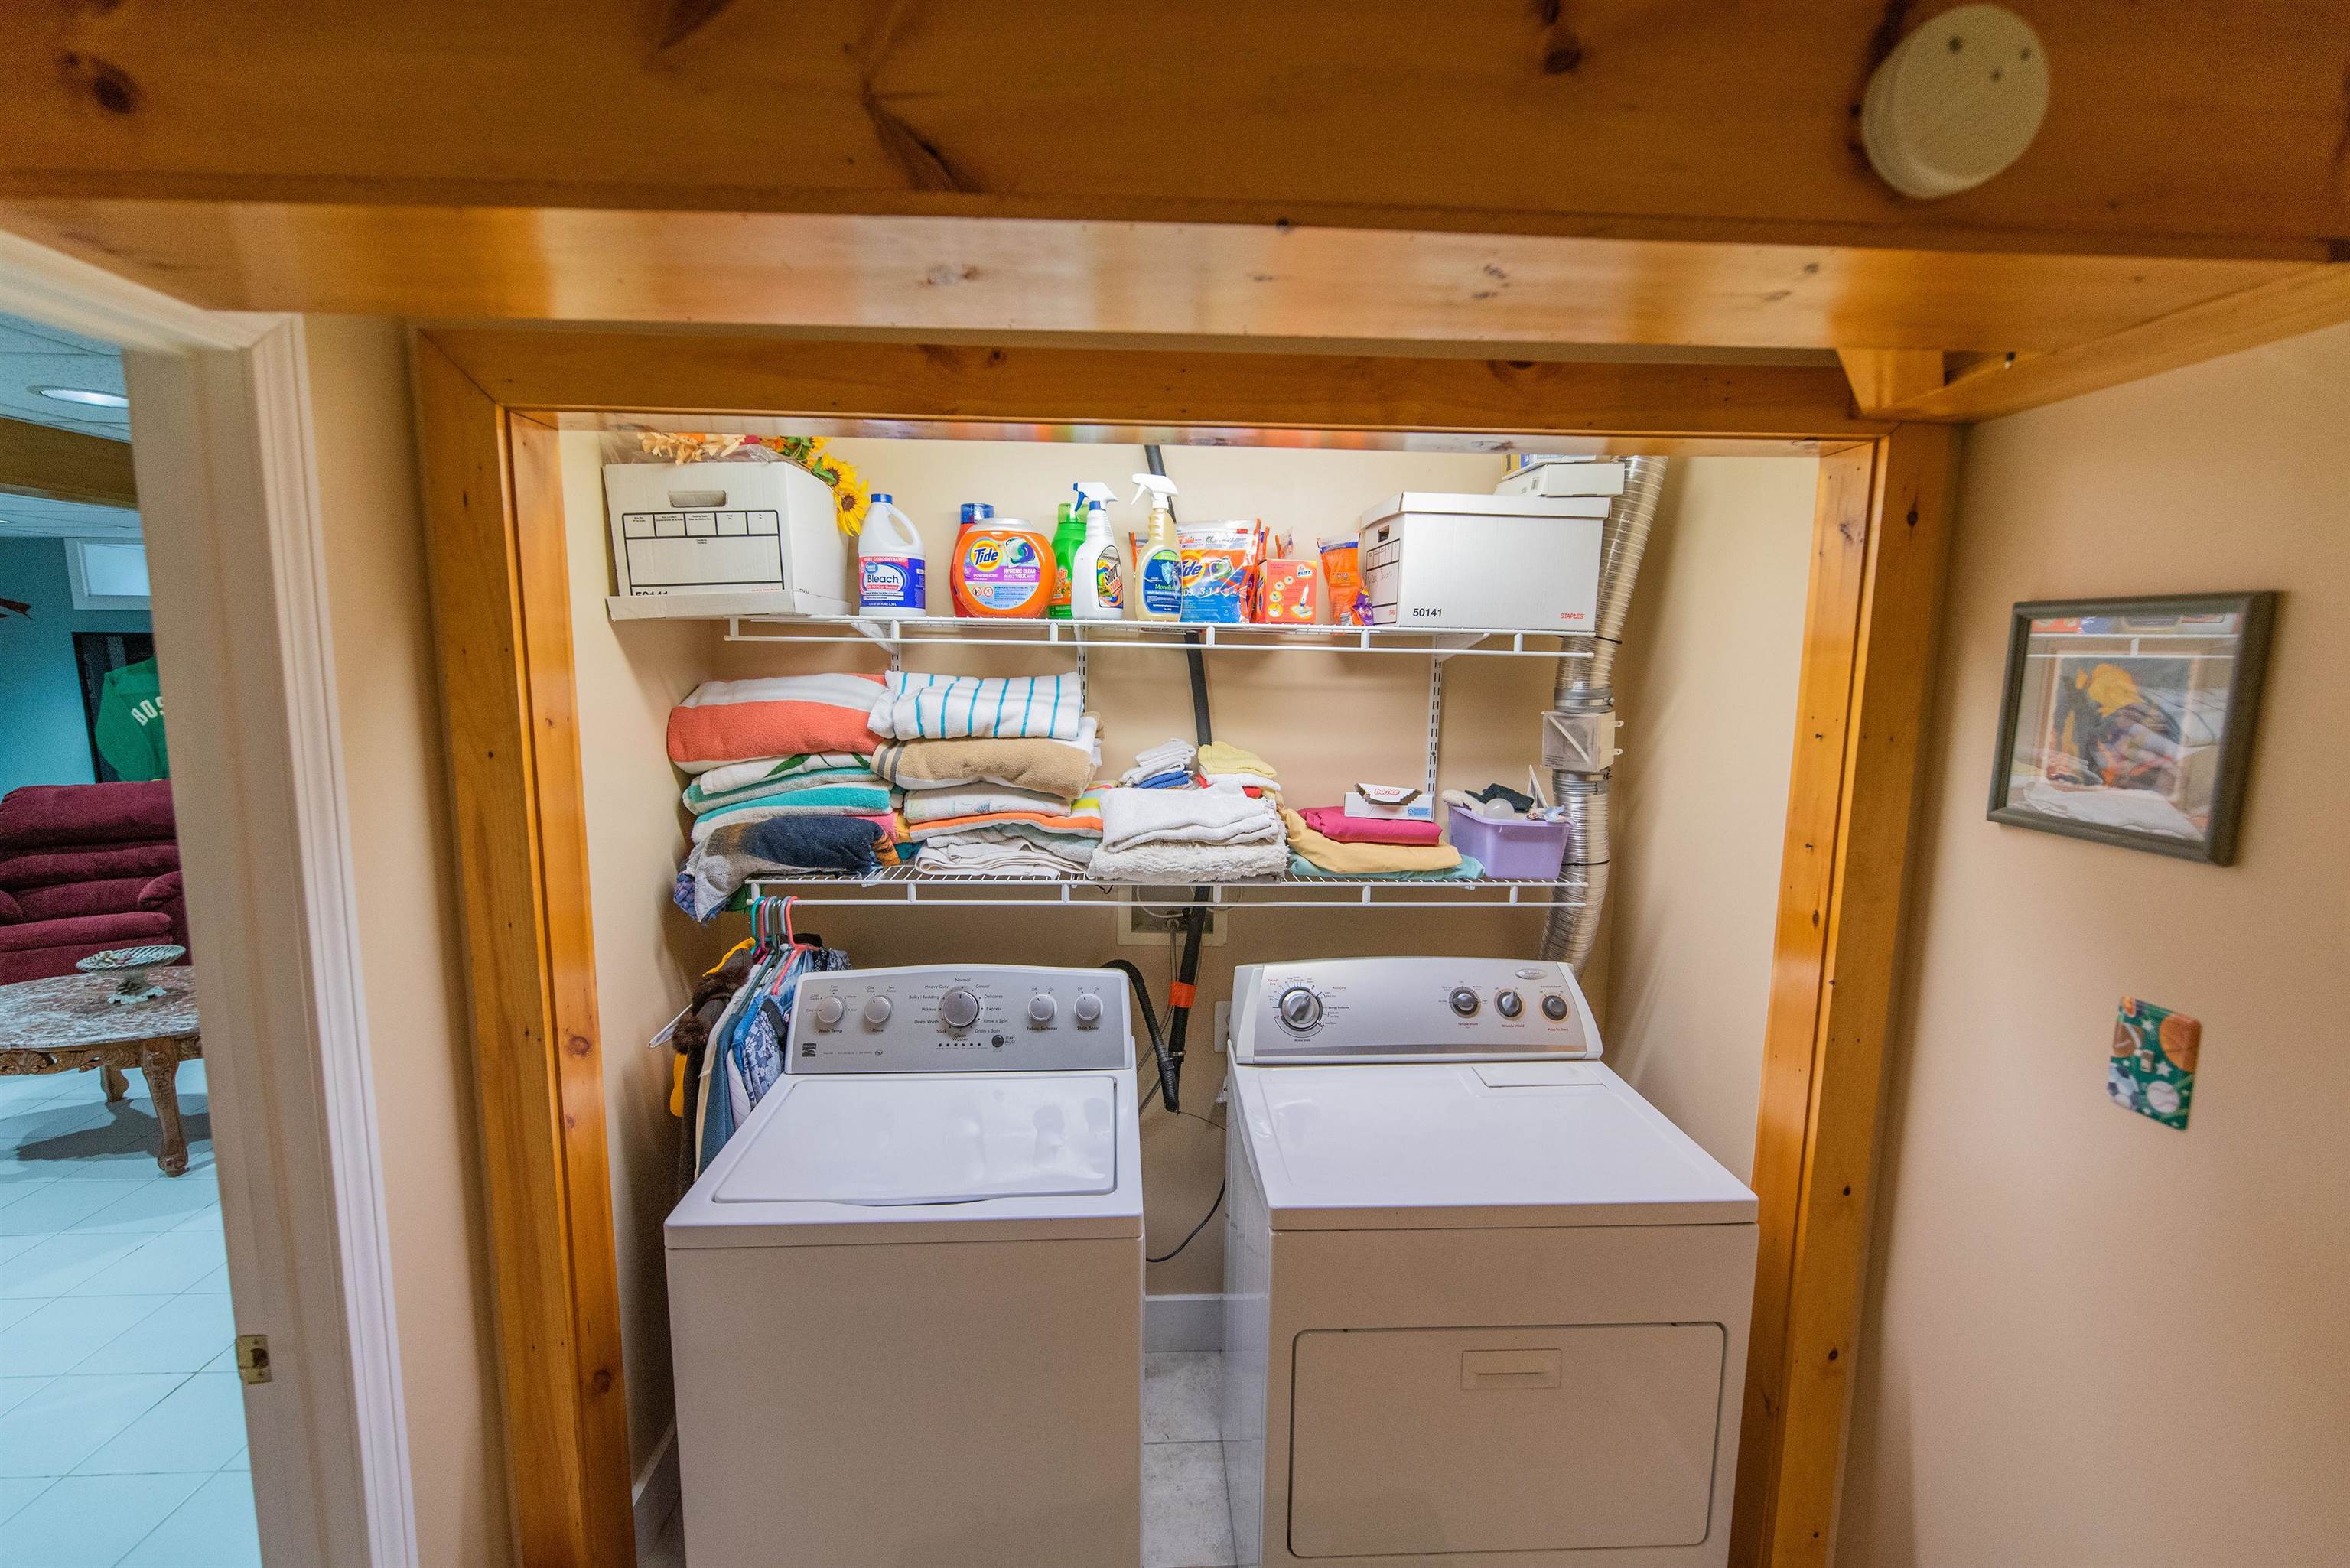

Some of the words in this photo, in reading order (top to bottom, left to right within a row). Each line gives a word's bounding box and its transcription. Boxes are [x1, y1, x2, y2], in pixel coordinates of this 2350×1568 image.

[974, 548, 999, 565] Tide
[867, 574, 899, 584] Bleach
[1413, 608, 1442, 617] 50141
